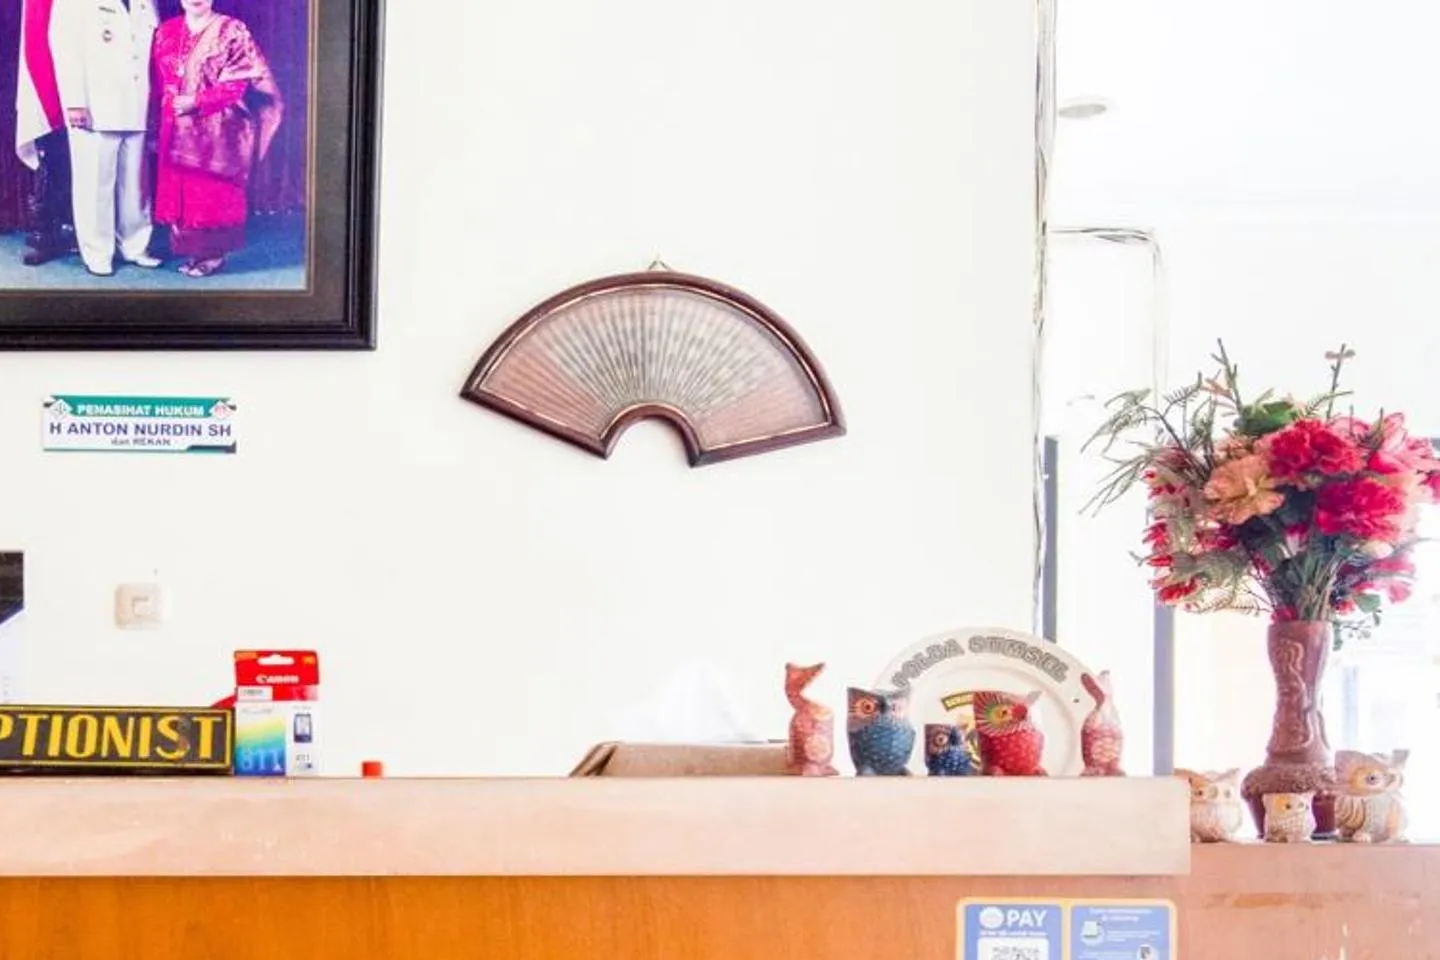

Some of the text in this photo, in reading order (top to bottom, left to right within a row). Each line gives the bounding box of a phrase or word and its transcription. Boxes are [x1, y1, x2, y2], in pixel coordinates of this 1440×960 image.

[77, 404, 205, 416] PENASIHAT HUKUM
[50, 422, 232, 437] H ANTON NURDIN SH
[1006, 909, 1049, 928] PAY
